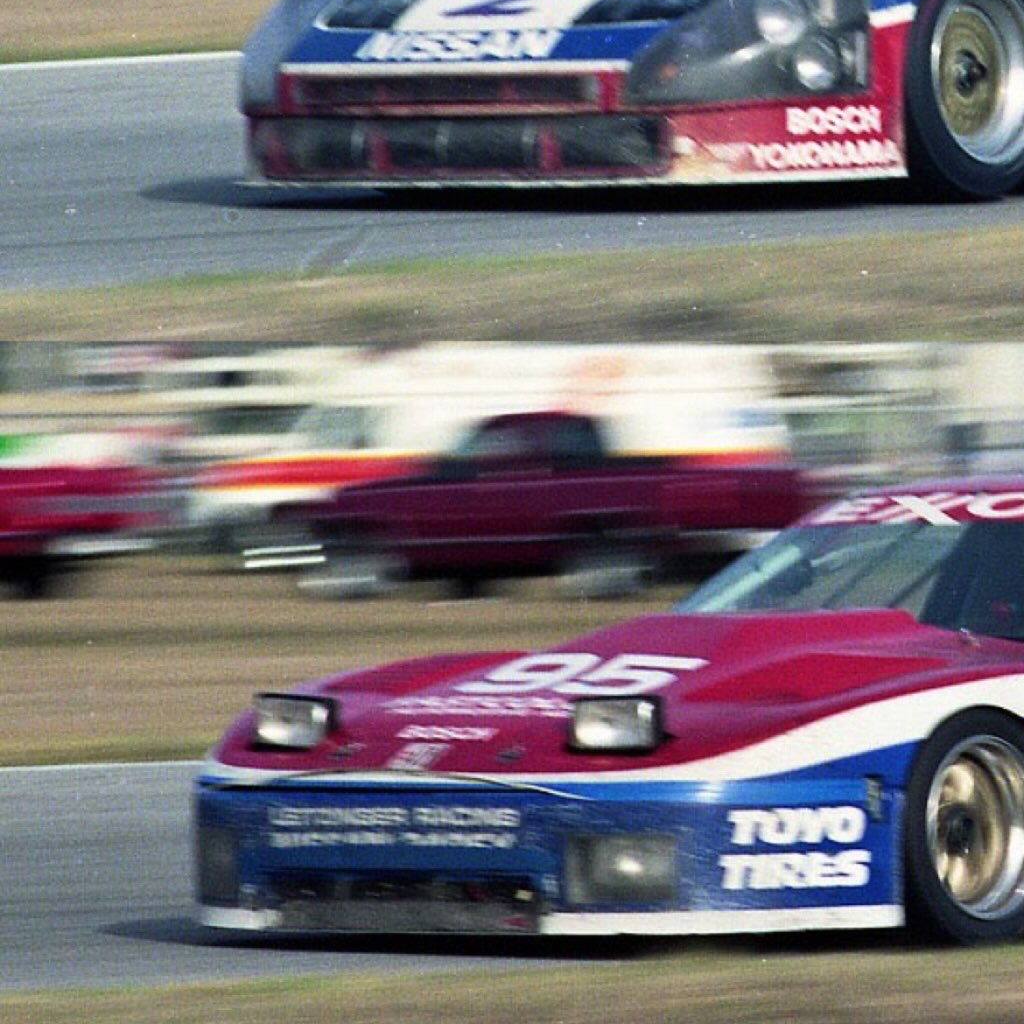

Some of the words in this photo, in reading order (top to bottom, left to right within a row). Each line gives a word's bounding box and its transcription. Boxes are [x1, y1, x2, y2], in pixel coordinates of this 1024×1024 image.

[352, 30, 565, 61] NISSAN
[786, 105, 882, 135] BOSCH
[453, 652, 710, 695] 95
[727, 806, 867, 846] TOYO
[717, 849, 872, 890] TIRES
